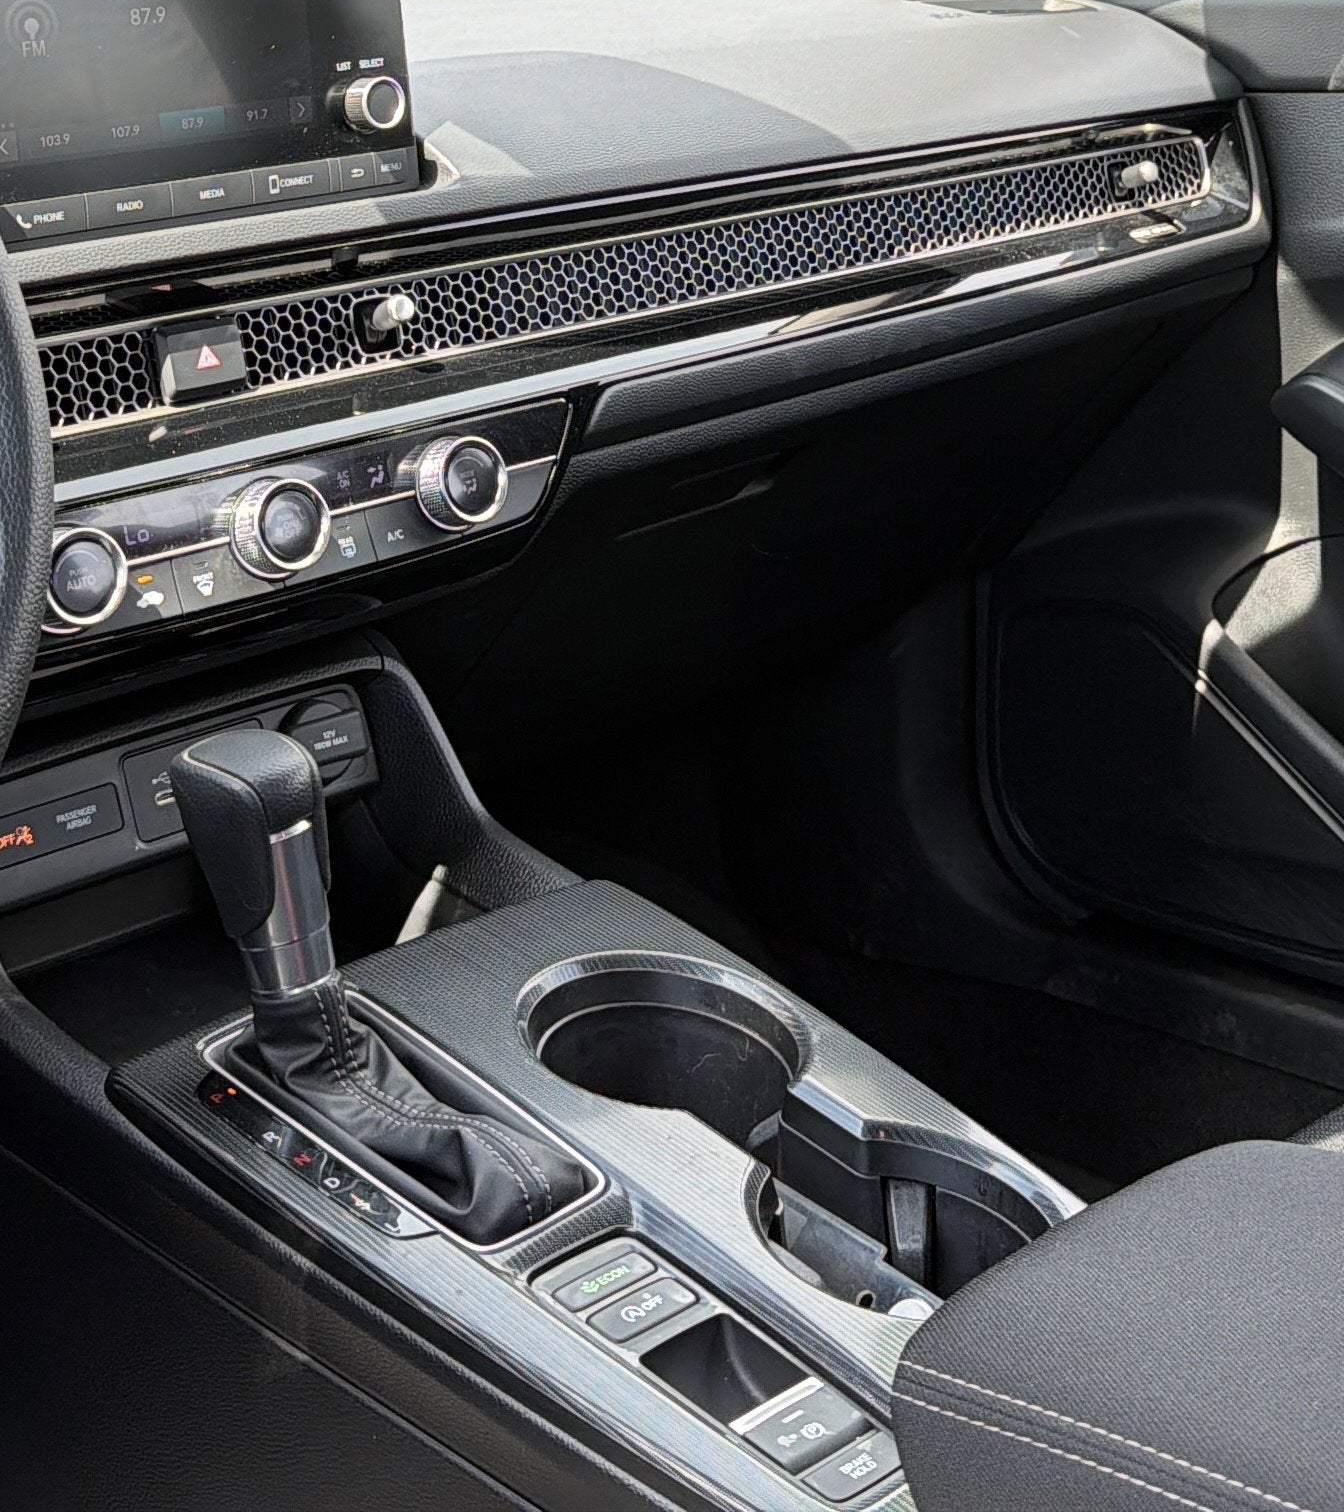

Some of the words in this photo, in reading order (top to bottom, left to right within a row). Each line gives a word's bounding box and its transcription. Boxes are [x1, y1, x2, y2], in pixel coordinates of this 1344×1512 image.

[130, 5, 166, 27] 87.9
[22, 40, 46, 58] FM
[246, 108, 269, 122] 91.7
[181, 116, 204, 130] 87.9
[111, 124, 140, 139] 107.9
[40, 133, 70, 148] 103.9
[380, 161, 402, 173] MENU
[279, 175, 314, 188] CONNECT
[199, 187, 226, 200] MEDIA
[116, 199, 144, 212] RADIO
[33, 210, 65, 225] PHONE
[387, 529, 405, 543] A/C
[66, 575, 96, 592] AUTO
[323, 729, 336, 740] 12V
[333, 735, 348, 746] MAX
[56, 804, 97, 824] PASSENGER
[66, 818, 92, 831] AIRBAG
[323, 1177, 341, 1189] D
[596, 1265, 631, 1286] ECON
[641, 1294, 664, 1311] OFF
[838, 1452, 873, 1475] BRAKE
[849, 1460, 878, 1479] HOLD
